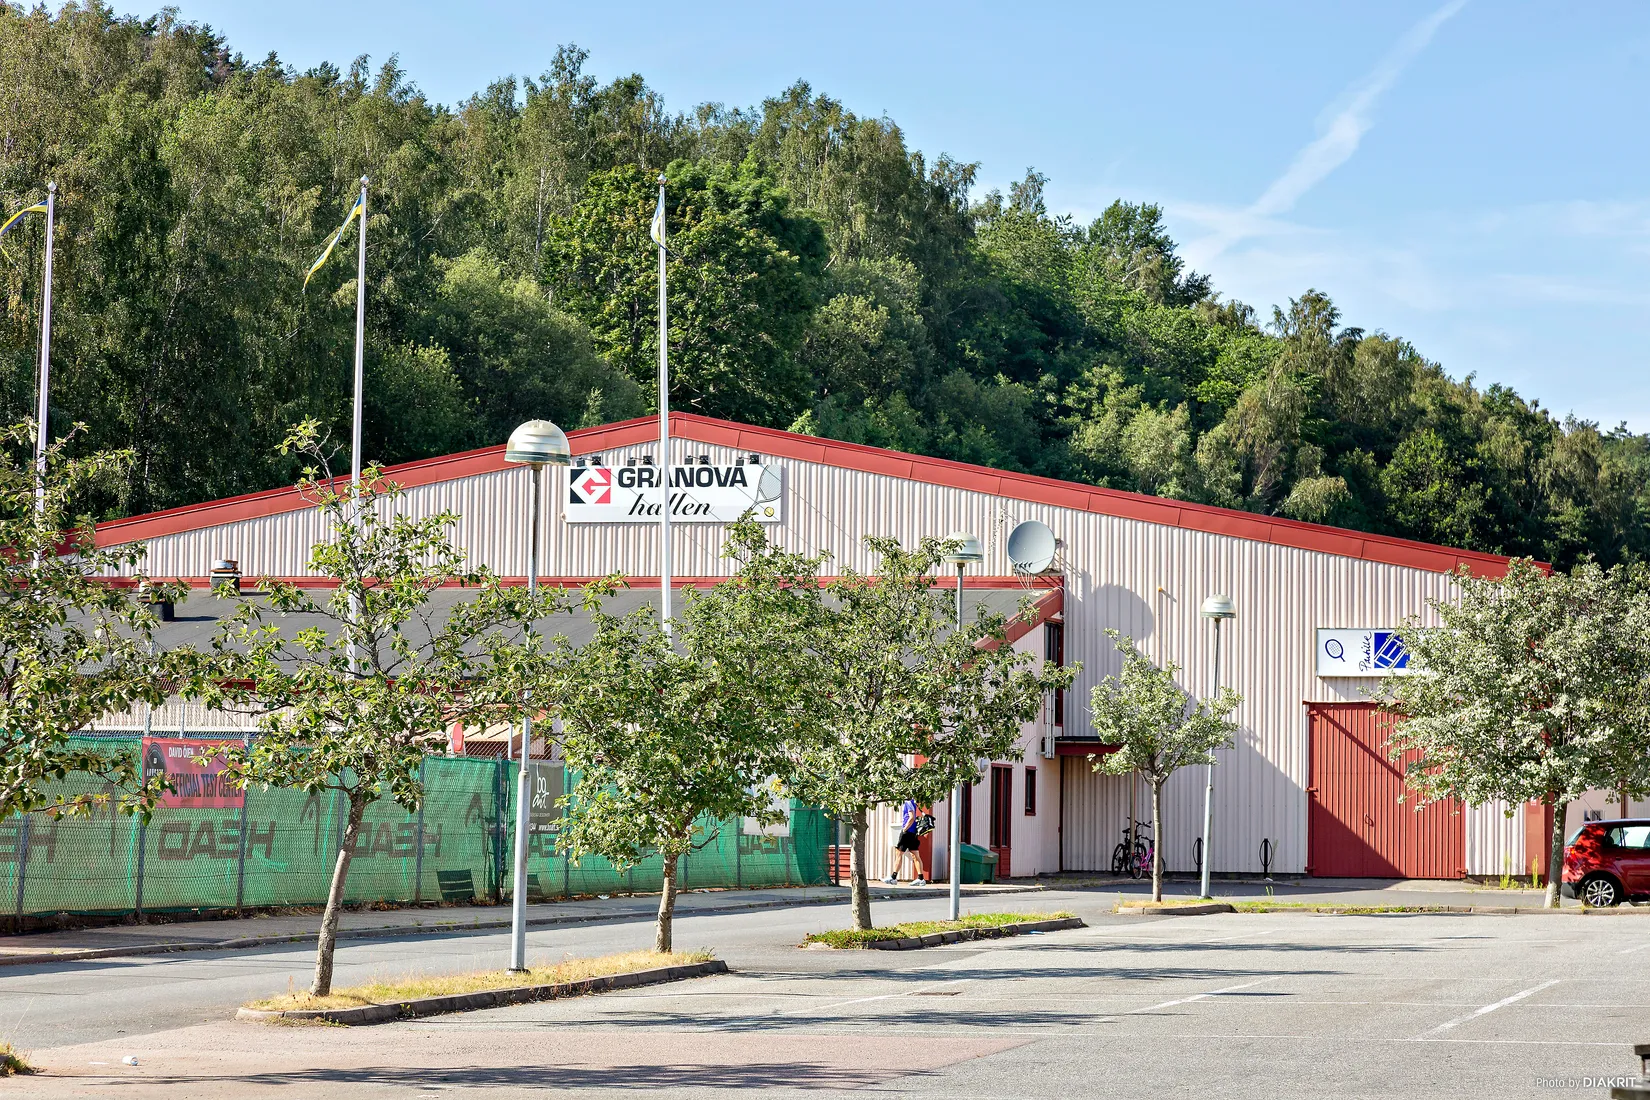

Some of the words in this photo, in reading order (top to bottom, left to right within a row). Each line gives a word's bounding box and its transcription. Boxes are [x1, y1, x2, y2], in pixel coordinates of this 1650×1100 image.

[618, 467, 748, 488] GRANOVA
[628, 493, 711, 516] hallen
[171, 773, 201, 797] OFFICIAL
[201, 773, 218, 797] TEST
